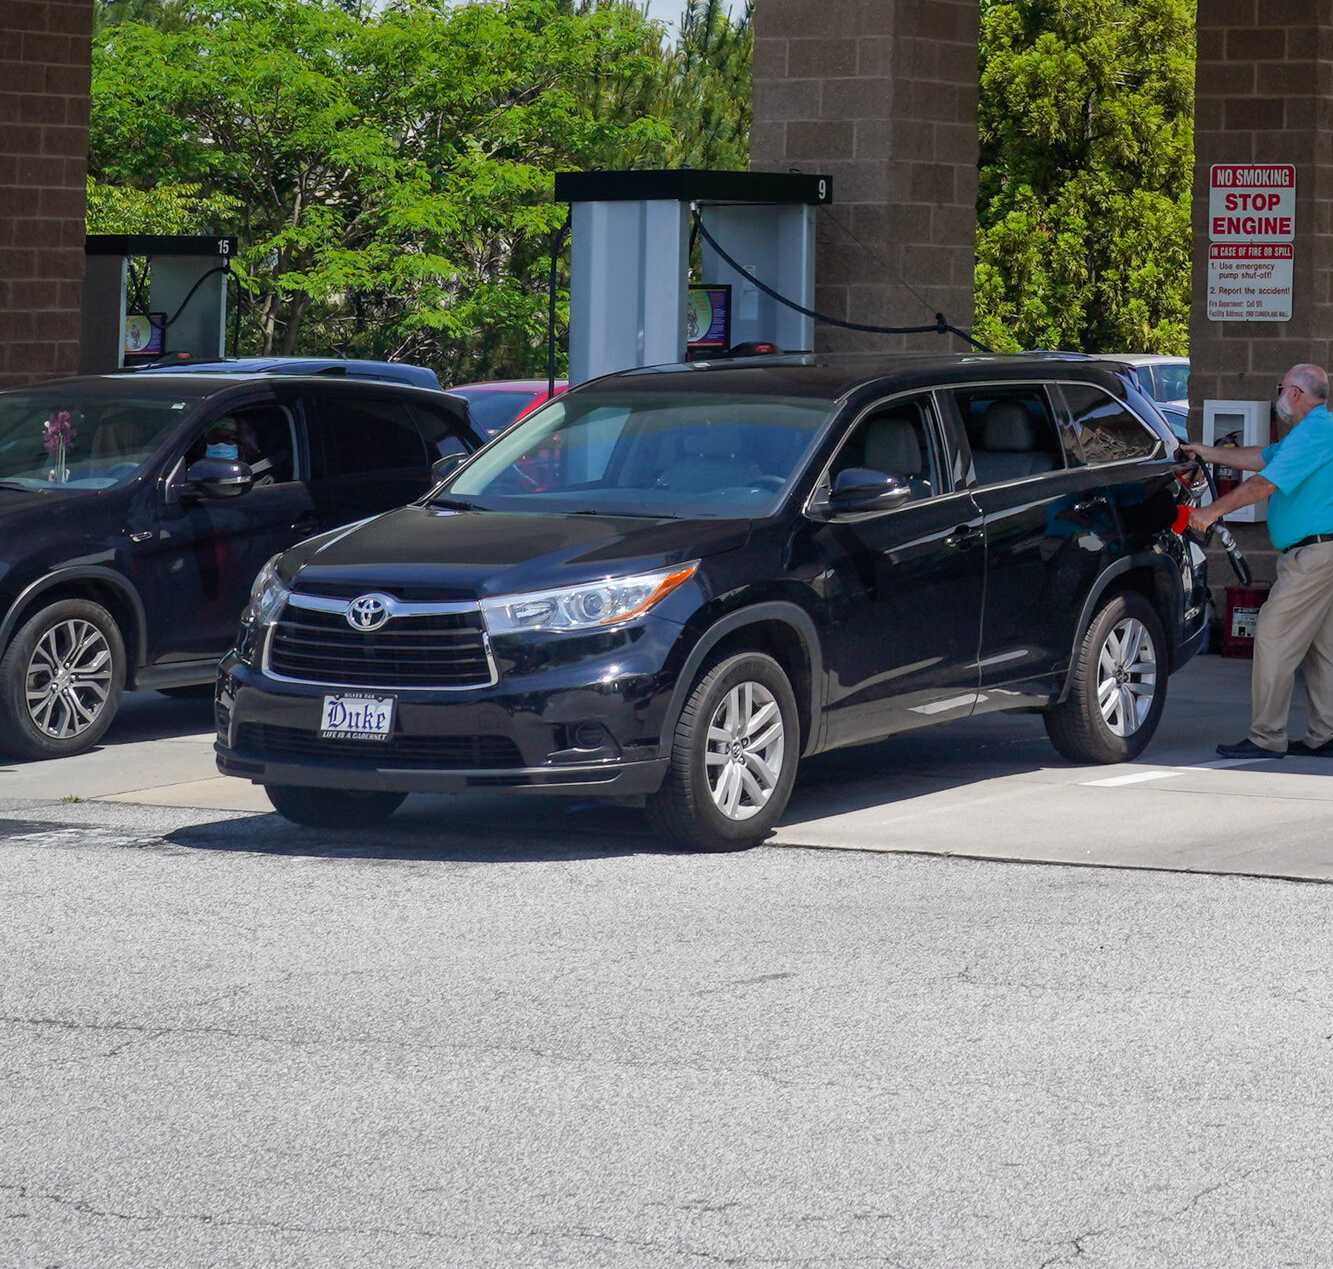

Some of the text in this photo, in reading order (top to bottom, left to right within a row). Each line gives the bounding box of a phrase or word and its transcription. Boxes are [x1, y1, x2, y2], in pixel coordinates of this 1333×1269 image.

[1216, 169, 1290, 186] NO SMOKING
[818, 179, 826, 200] 9
[1225, 193, 1281, 211] STOP
[1212, 217, 1291, 235] ENGINE
[218, 240, 229, 254] 15
[1211, 246, 1291, 257] IN CASE OF FIRE OR SPILL
[1235, 264, 1275, 272] emergency
[1219, 287, 1242, 295] Report
[328, 700, 386, 730] Duke
